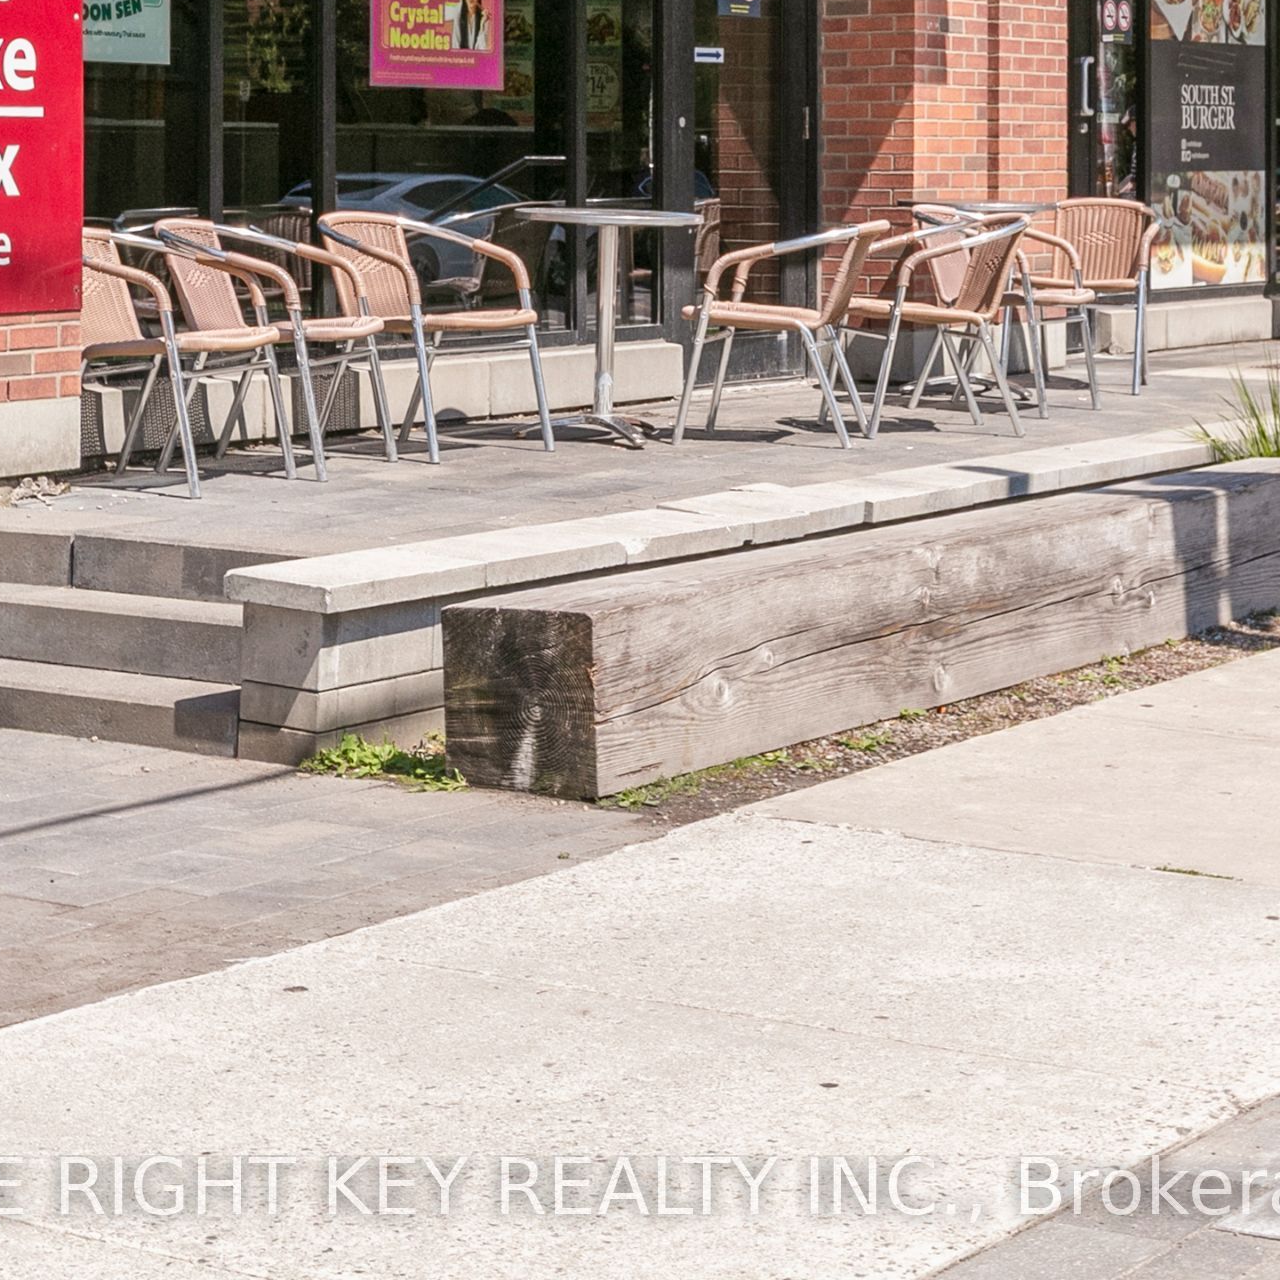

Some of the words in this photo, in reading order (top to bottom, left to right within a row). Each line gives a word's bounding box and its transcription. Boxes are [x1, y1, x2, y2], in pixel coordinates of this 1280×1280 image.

[389, 1, 444, 30] Crystal
[389, 26, 451, 51] Noodles
[1181, 83, 1220, 105] SOUTH
[1220, 85, 1236, 106] ST.
[1181, 105, 1236, 130] BURGER
